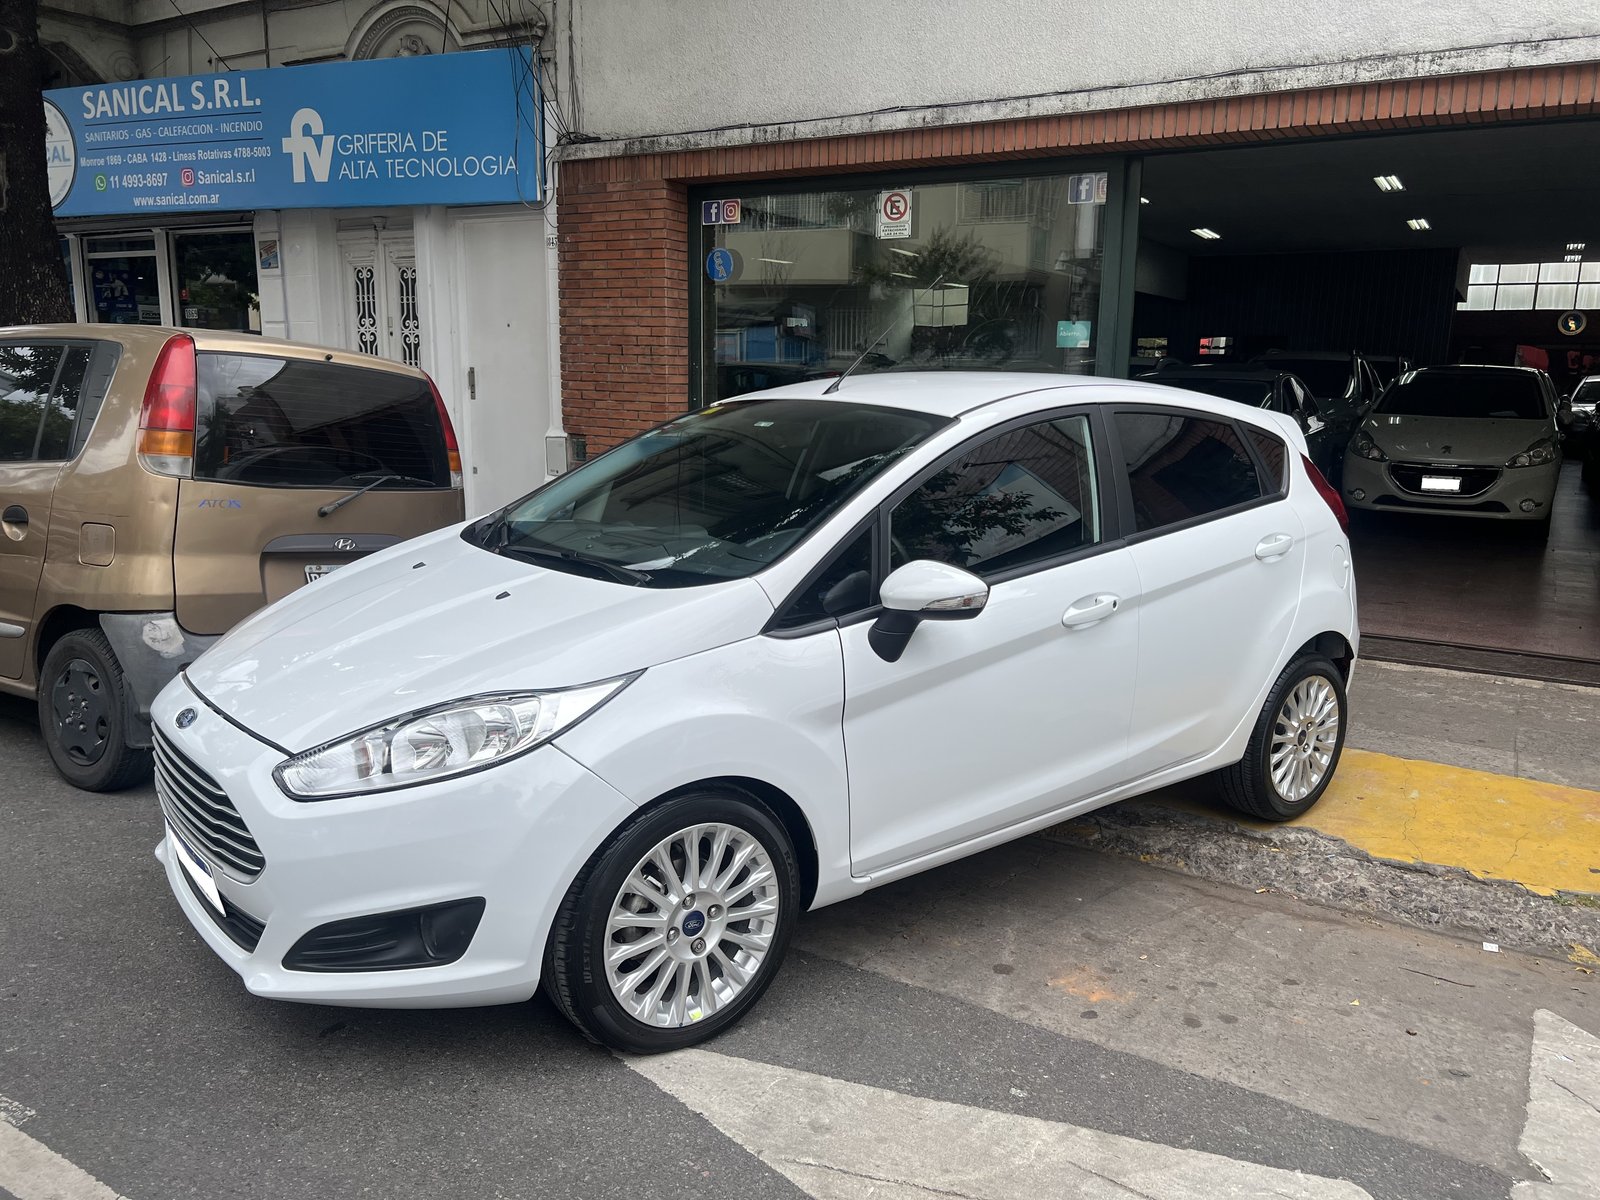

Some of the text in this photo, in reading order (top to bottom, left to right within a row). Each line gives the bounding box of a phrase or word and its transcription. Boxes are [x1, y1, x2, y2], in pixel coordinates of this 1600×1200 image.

[82, 77, 261, 119] SANICAL S.R.L.
[85, 129, 129, 143] SANITARIOS
[135, 128, 151, 139] GAS
[158, 123, 213, 137] CALEFACCION
[220, 120, 263, 133] INCENDIO
[337, 130, 448, 156] GRIFERIA DE
[127, 153, 148, 164] CABA
[151, 151, 167, 162] 1428
[197, 149, 232, 160] Rotativas
[198, 168, 256, 185] Sanical.s.r.l
[339, 154, 519, 180] ALTA TECNOLOGIA
[110, 172, 168, 188] 11 4993-8697
[133, 192, 220, 206] www.sanical.com.ar
